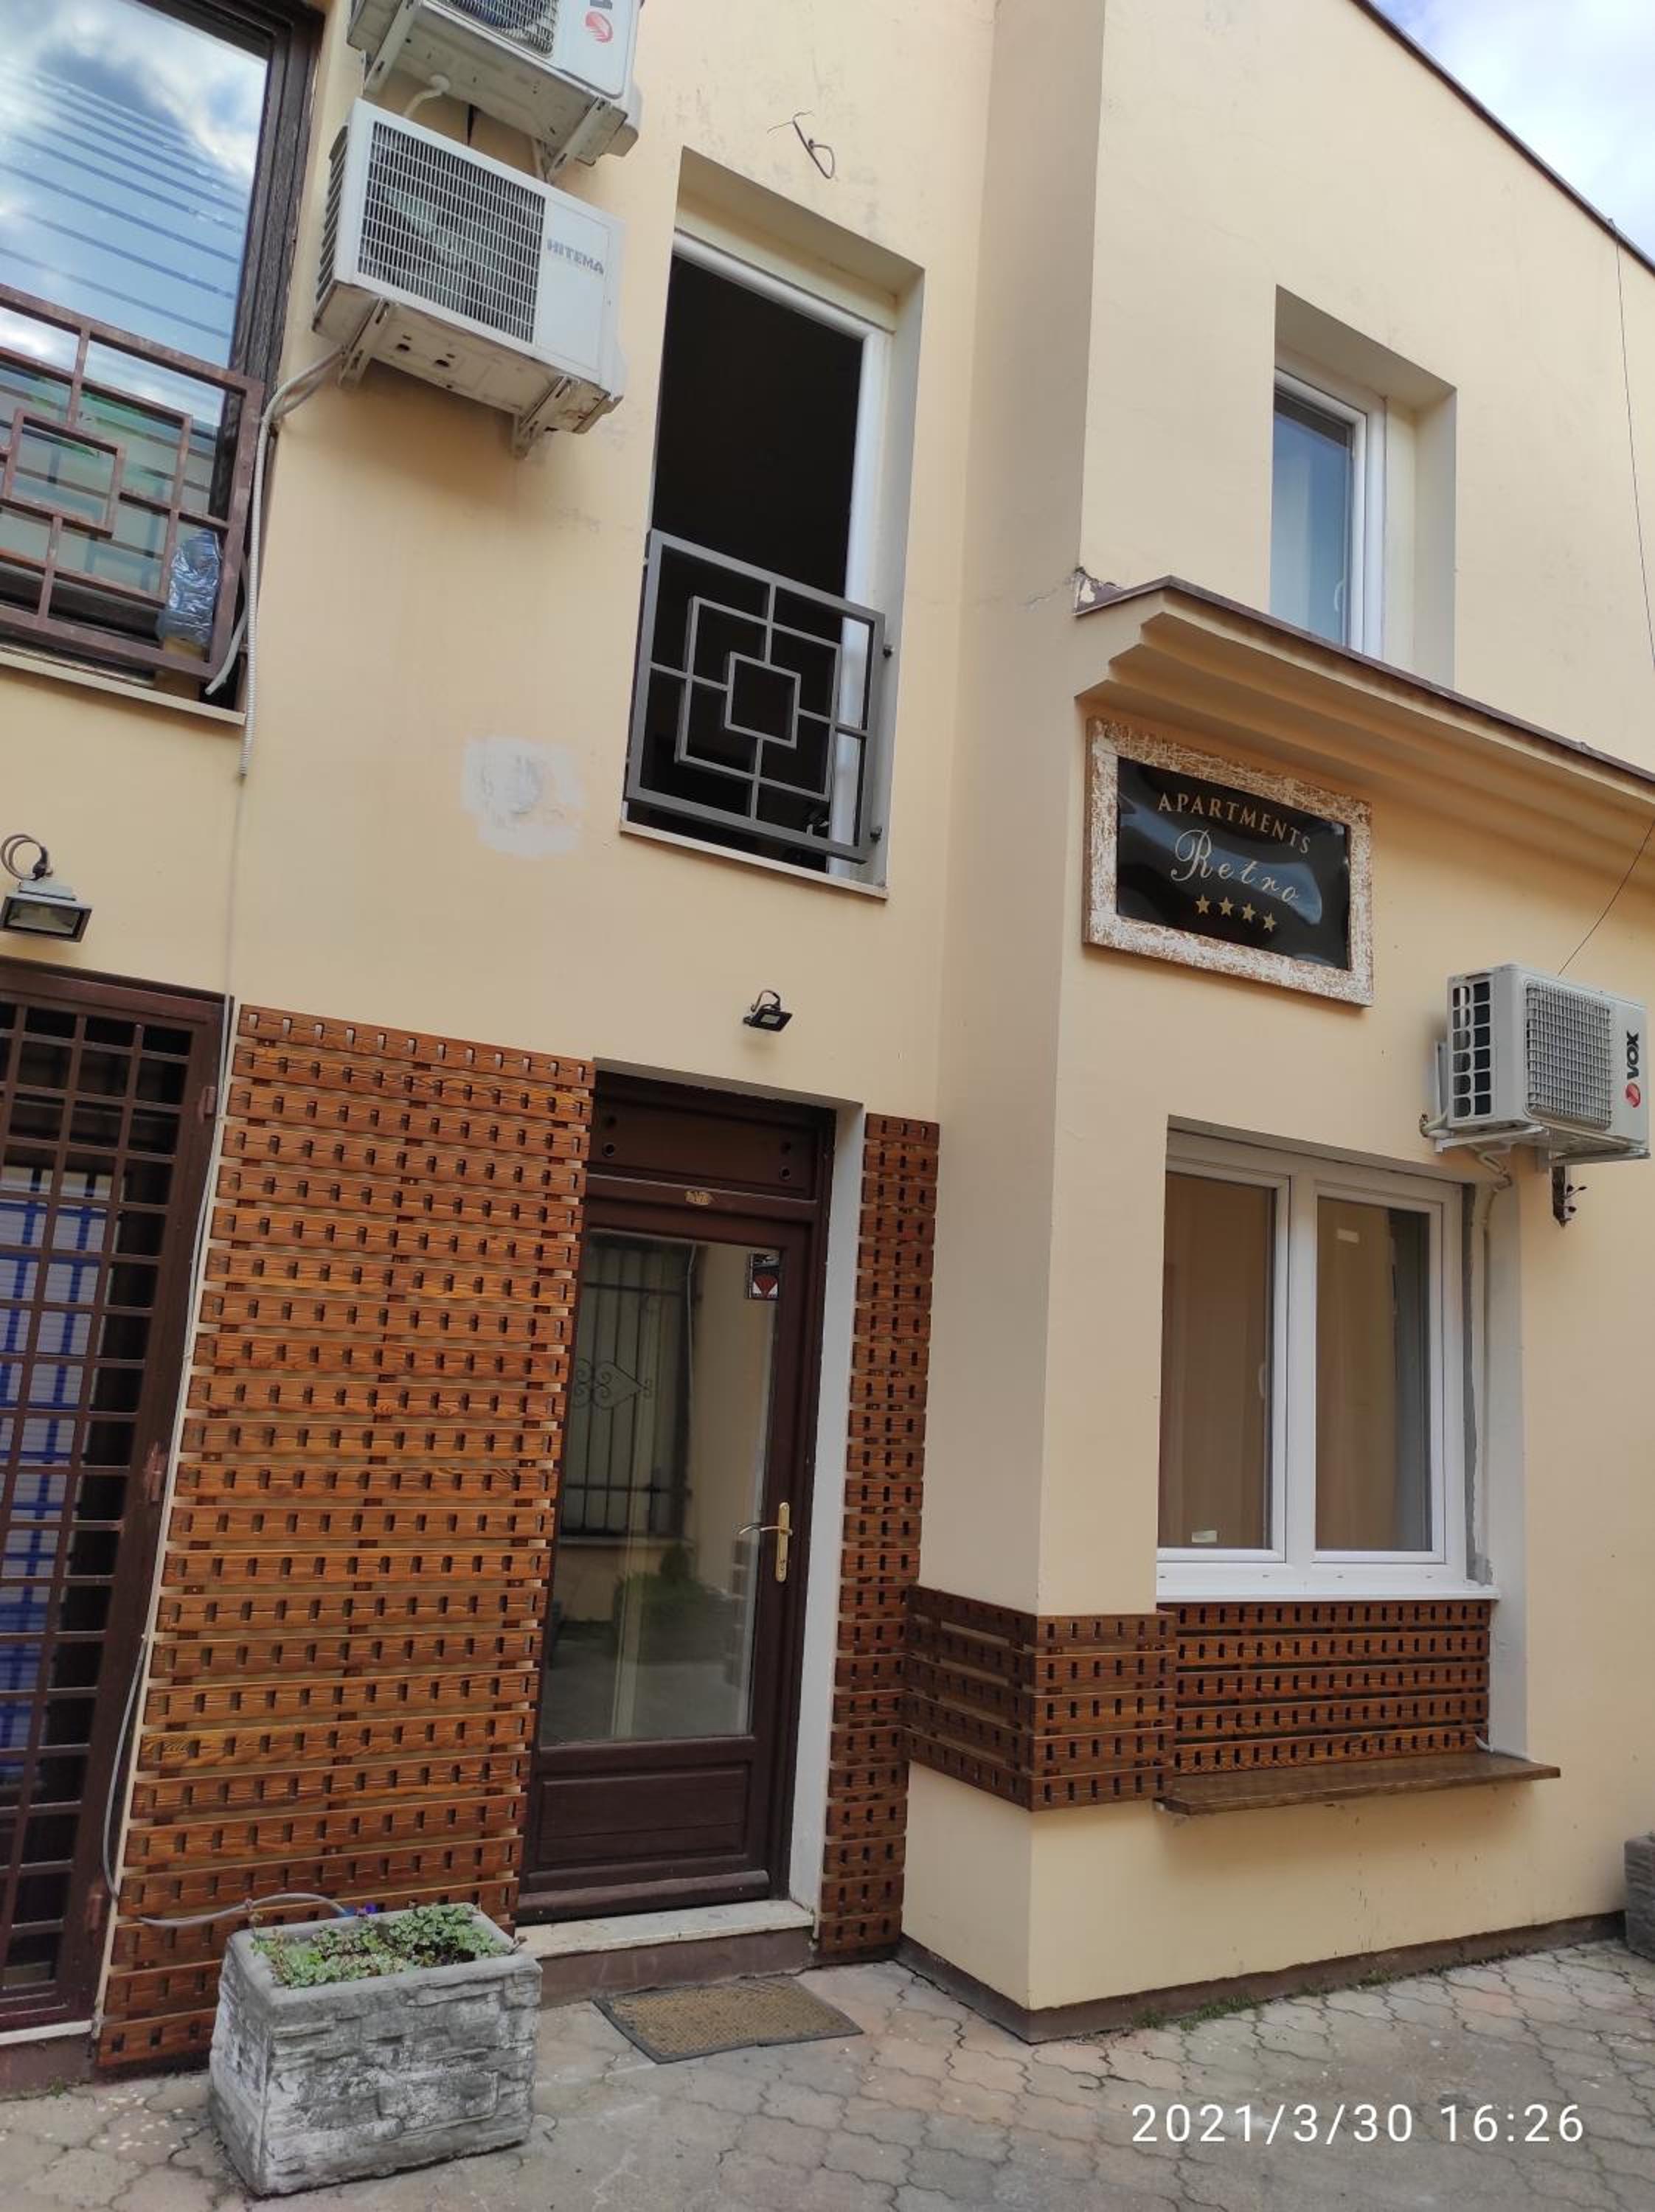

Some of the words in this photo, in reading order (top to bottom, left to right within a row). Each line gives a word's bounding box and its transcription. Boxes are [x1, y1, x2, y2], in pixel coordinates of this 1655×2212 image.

[547, 238, 603, 274] HITEMA
[1158, 792, 1310, 853] APARTMENTS
[1626, 1030, 1639, 1079] VOX
